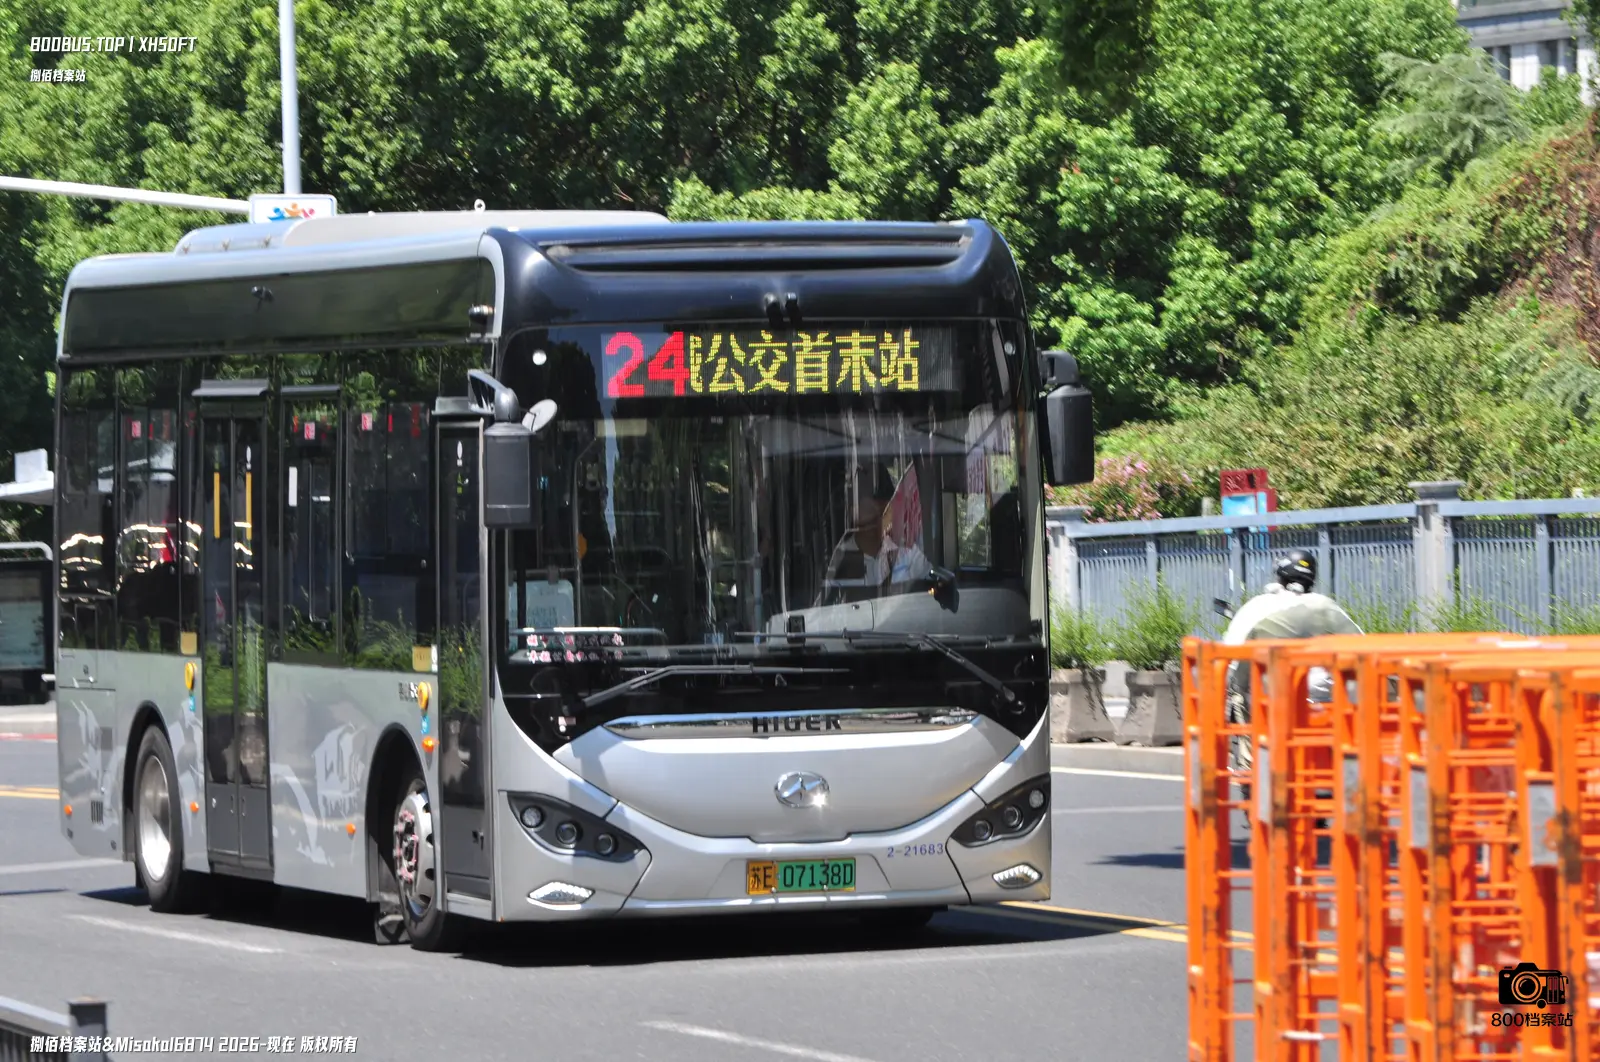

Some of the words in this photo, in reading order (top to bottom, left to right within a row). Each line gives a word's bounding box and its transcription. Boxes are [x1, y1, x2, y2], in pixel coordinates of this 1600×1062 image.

[605, 330, 690, 398] 24
[752, 714, 842, 734] HIGER
[887, 843, 944, 858] 2-21683
